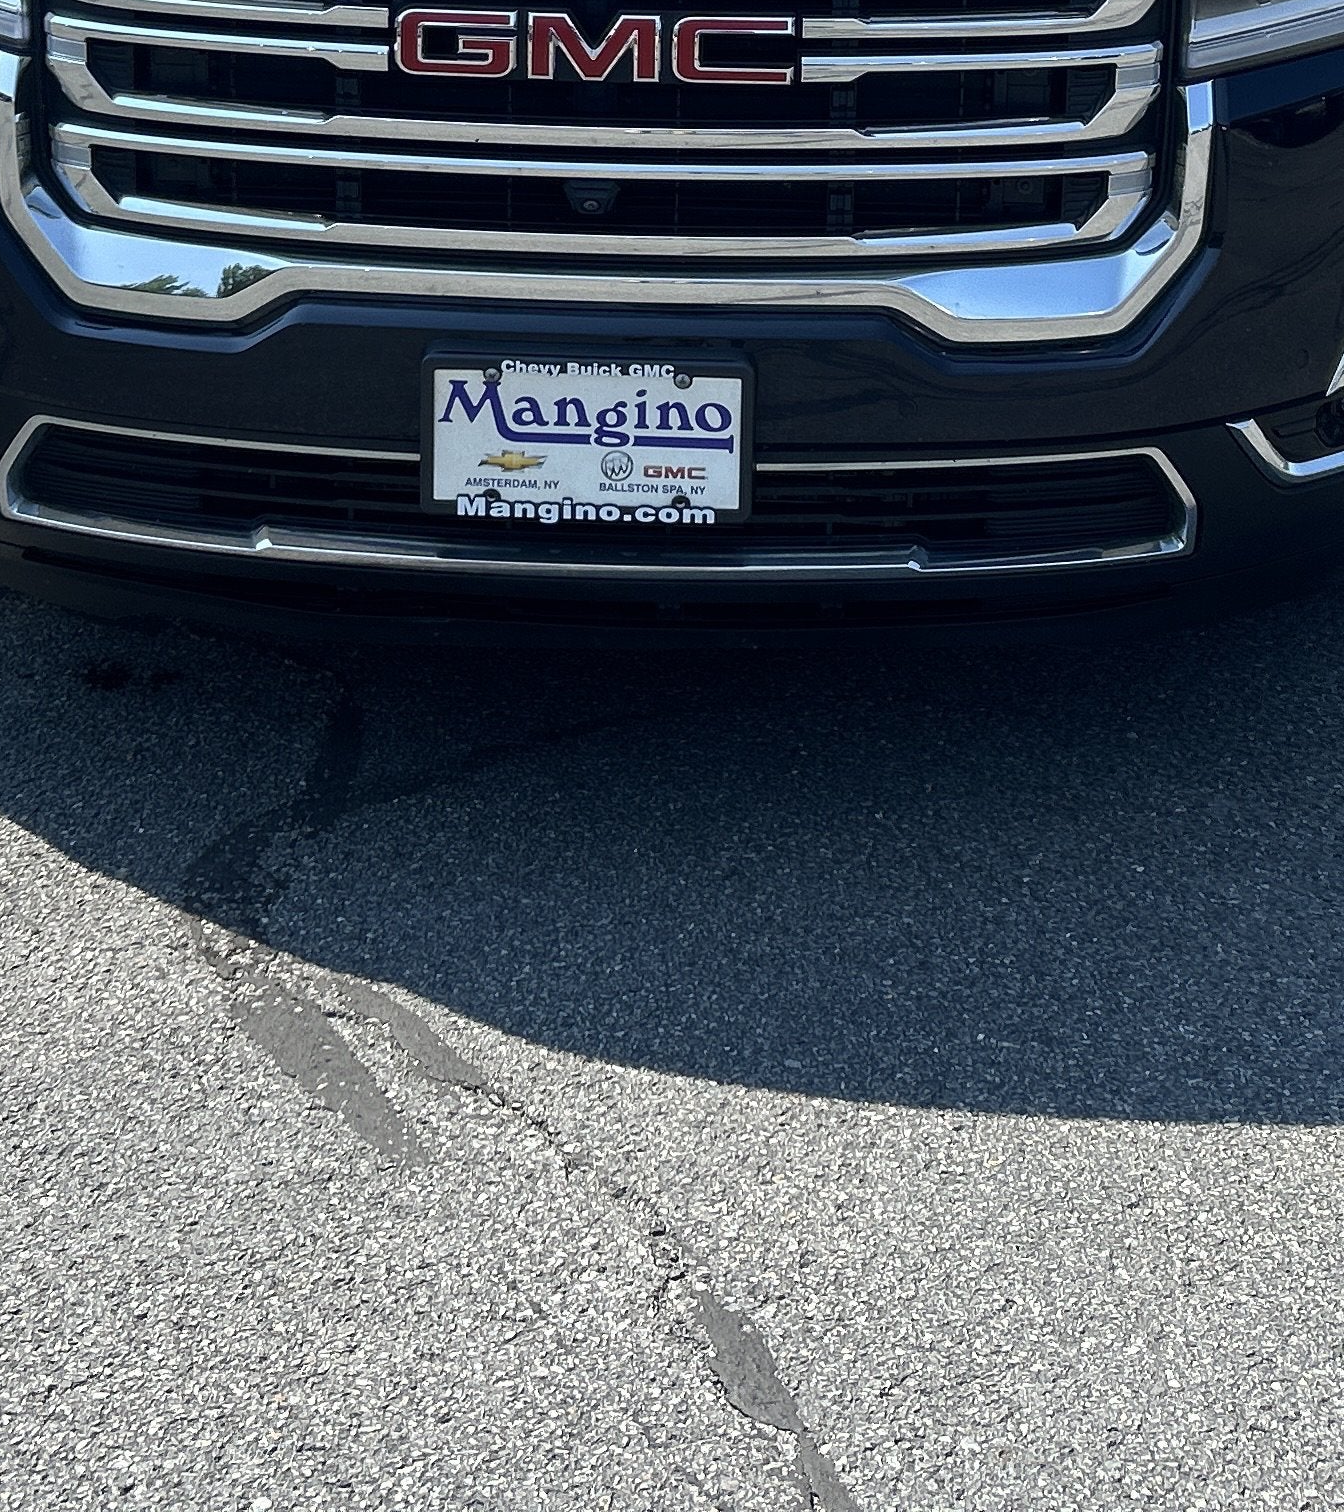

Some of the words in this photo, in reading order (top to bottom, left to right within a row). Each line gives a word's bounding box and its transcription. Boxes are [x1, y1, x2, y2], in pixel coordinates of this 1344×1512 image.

[394, 8, 796, 85] GMC
[501, 359, 562, 377] Chevy
[567, 362, 623, 377] Buick
[629, 364, 675, 378] GMC
[438, 379, 734, 448] Mangino
[643, 464, 708, 481] GMC
[465, 477, 541, 490] AMSTERDAM,
[544, 479, 560, 490] NY
[599, 482, 658, 494] BALLSTON
[661, 484, 687, 496] SPA,
[690, 485, 706, 496] NY
[457, 495, 716, 524] Mangino.com
